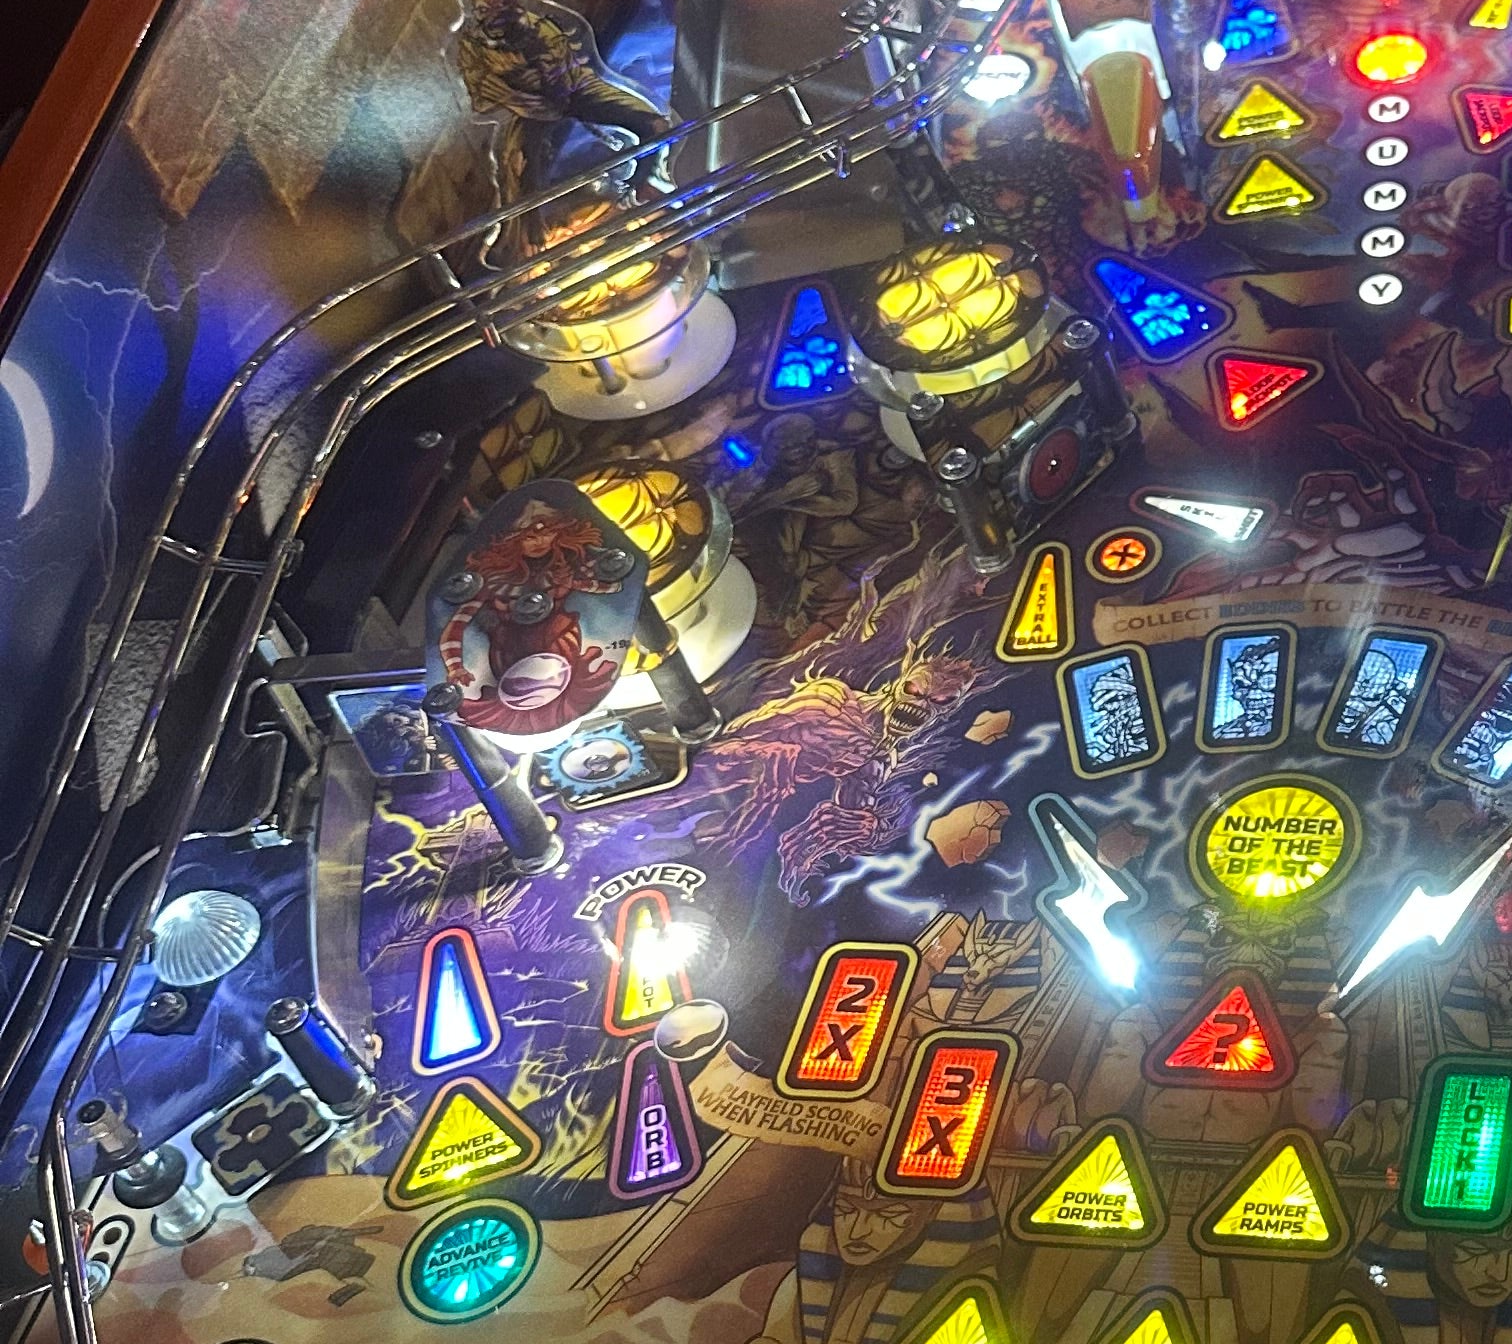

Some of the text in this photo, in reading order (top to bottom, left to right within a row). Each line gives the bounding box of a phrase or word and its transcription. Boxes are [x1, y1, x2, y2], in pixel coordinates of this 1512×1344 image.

[1032, 582, 1049, 632] EXTRA
[1112, 605, 1212, 633] COLLECT
[1311, 599, 1342, 614] TO
[1348, 598, 1431, 623] BATTLE
[1438, 607, 1483, 632] THE
[1015, 633, 1056, 645] BALL
[1223, 815, 1338, 836] NUMBER
[1228, 836, 1323, 856] OF THE
[1226, 857, 1315, 877] BEAST
[577, 865, 704, 918] POWER
[697, 1089, 862, 1149] WHEN FLASHING
[721, 1081, 883, 1139] PLAYFIELD SCORING
[643, 1107, 664, 1171] ORB
[1455, 1082, 1486, 1172] LOCK
[419, 1141, 509, 1179] SPINNERS
[430, 1132, 495, 1161] POWER
[1056, 1205, 1123, 1223] ORBITS
[1061, 1190, 1128, 1209] POWER
[1242, 1201, 1308, 1219] POWER
[1239, 1217, 1304, 1235] RAMPS
[428, 1230, 511, 1270] ADVANCE
[436, 1249, 501, 1282] REVIVE
